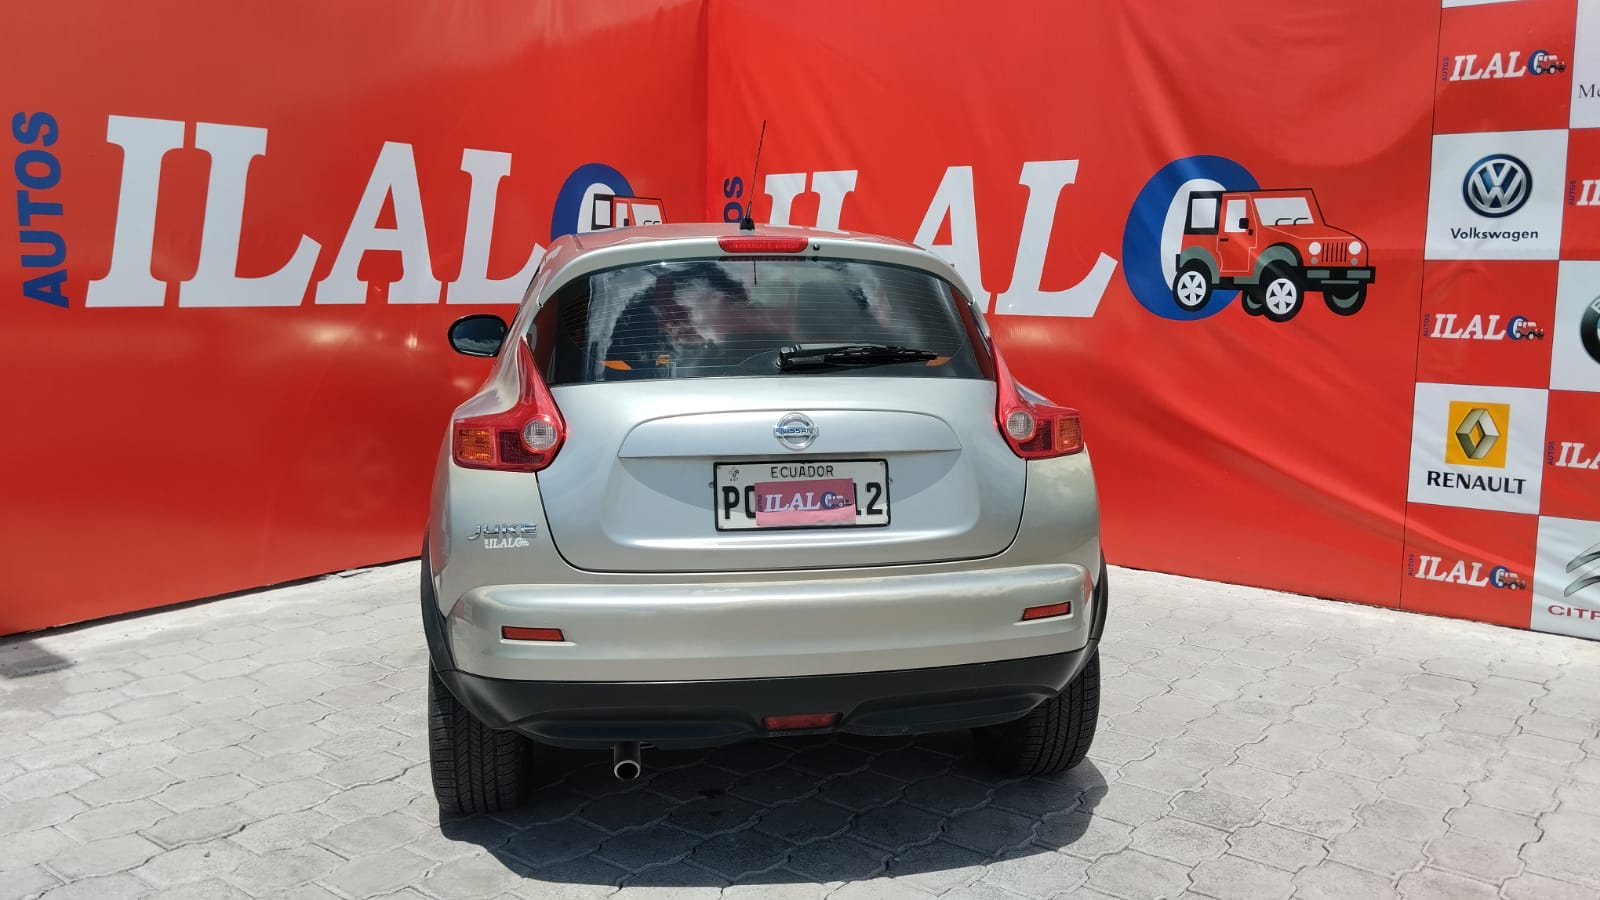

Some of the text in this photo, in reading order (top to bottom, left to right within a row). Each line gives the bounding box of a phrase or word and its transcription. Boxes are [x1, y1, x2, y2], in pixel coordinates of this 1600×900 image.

[12, 110, 69, 308] AUTOS
[1450, 227, 1539, 241] Volkswagen
[770, 465, 834, 478] ECUADOR
[1427, 470, 1527, 495] RENAULT
[467, 523, 537, 540] JUKE
